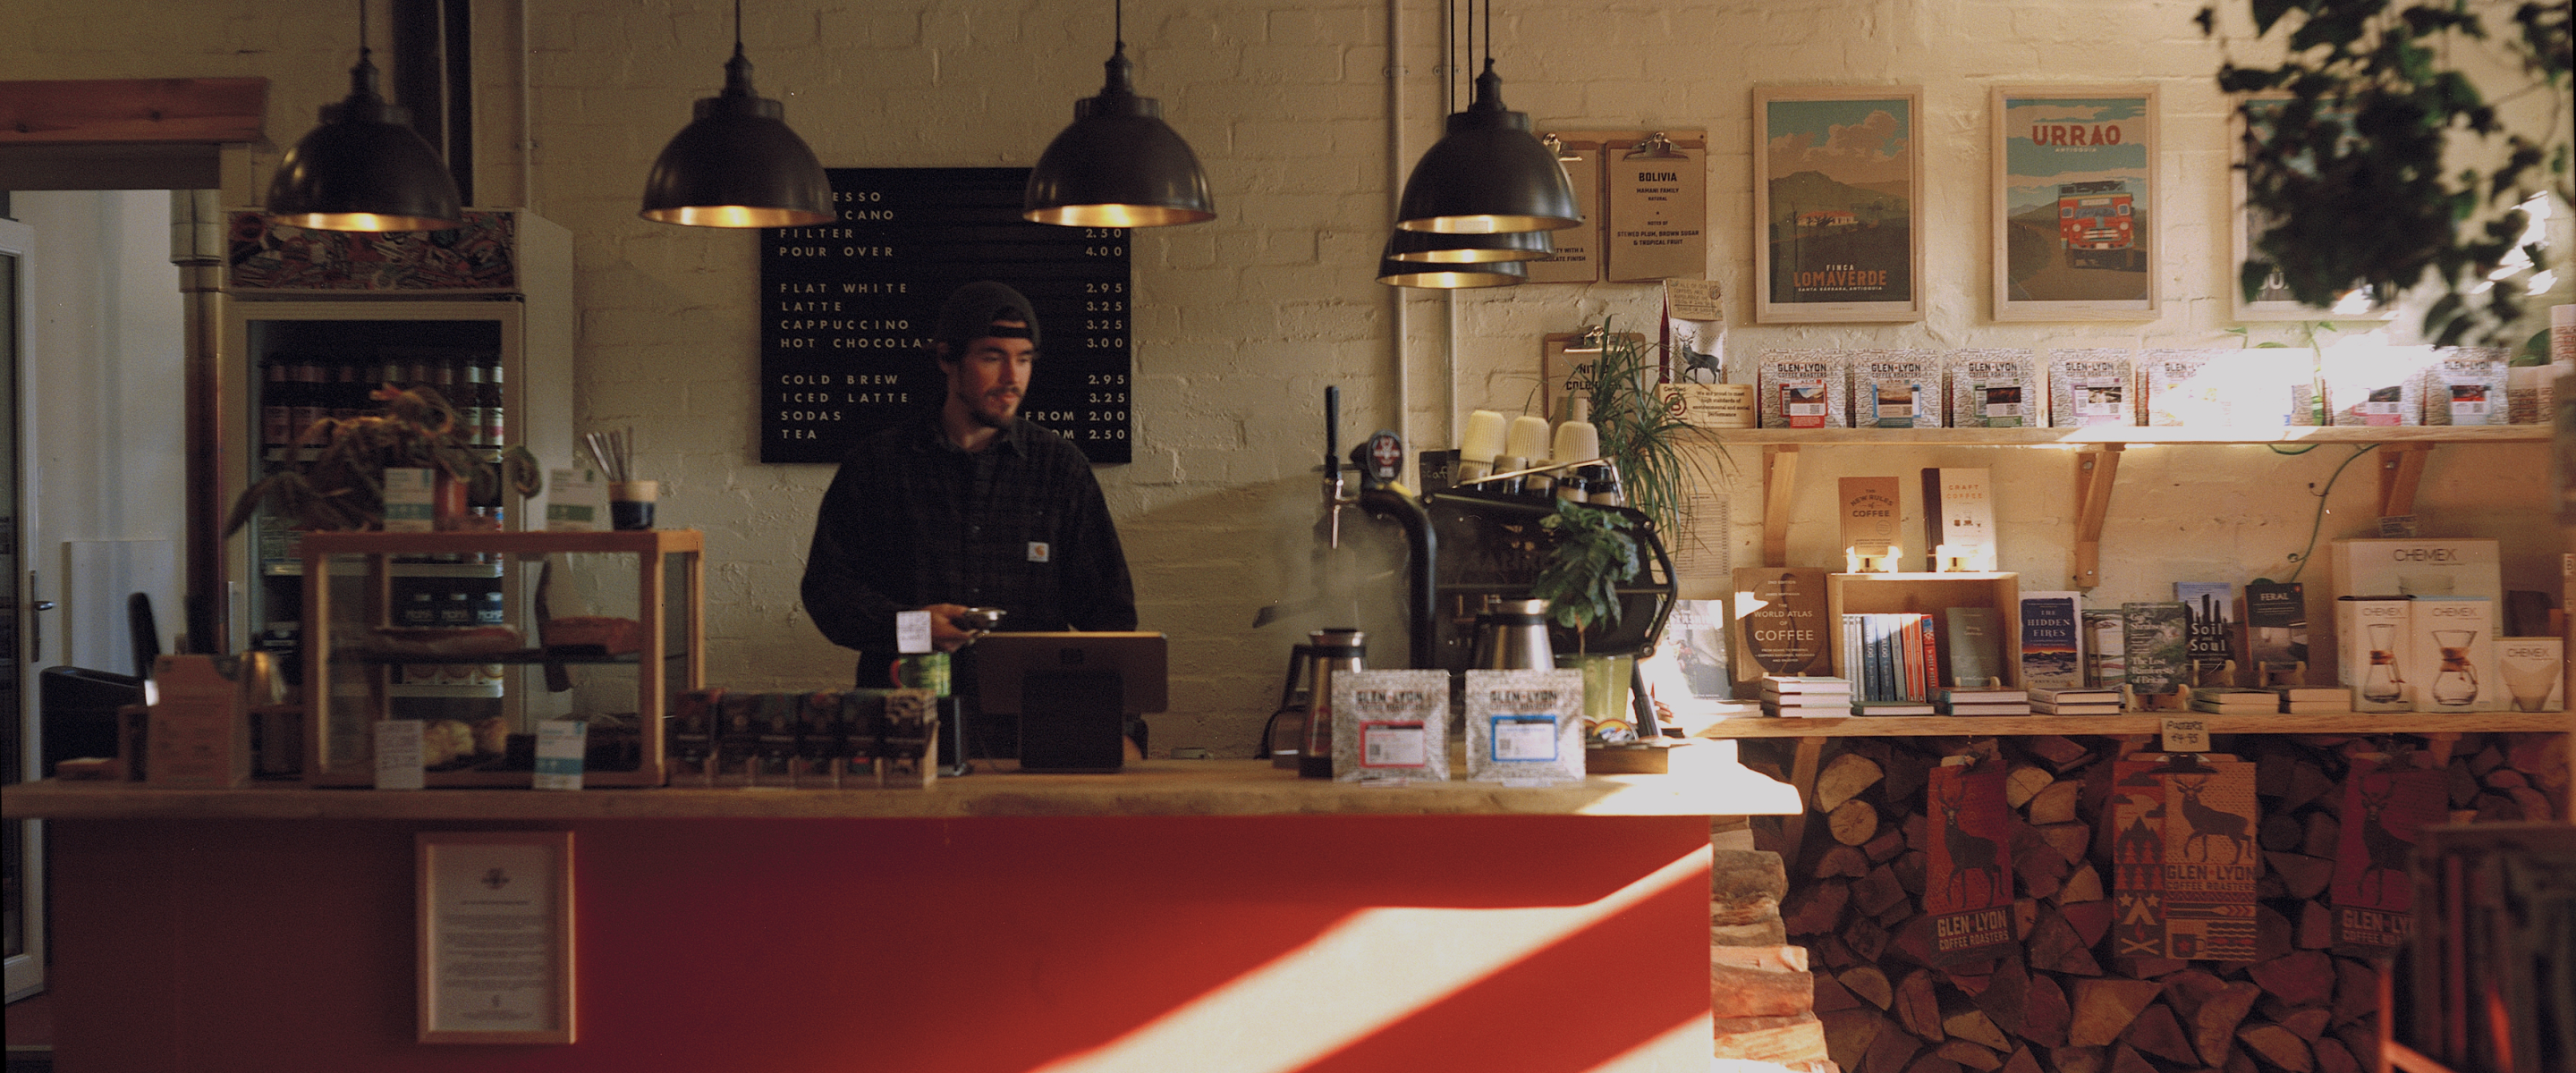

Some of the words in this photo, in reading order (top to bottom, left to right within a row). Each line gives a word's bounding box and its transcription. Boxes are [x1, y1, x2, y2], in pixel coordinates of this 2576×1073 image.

[2032, 125, 2121, 146] URRAO
[1639, 173, 1677, 182] BOLIVIA
[833, 192, 881, 202] ESSO
[780, 229, 853, 238] FILTER
[1086, 229, 1122, 238] 2.50
[780, 247, 826, 257] POUR
[844, 247, 893, 257] OVER
[1086, 247, 1122, 256] 4.00
[1793, 270, 1886, 287] LOMAVERDE
[781, 284, 826, 293] FLAT
[843, 284, 907, 293] WHITE
[1087, 283, 1122, 293] 2.95
[783, 302, 842, 311] LATTE
[1087, 302, 1122, 311] 3.25
[781, 320, 909, 329] CAPPUCCINO
[1087, 320, 1122, 330] 3.25
[781, 339, 815, 348] HOT
[834, 339, 934, 348] CHOCOLA
[1087, 338, 1123, 348] 3.00
[1778, 364, 1800, 372] GLEN
[1804, 364, 1826, 372] LYON
[1871, 364, 1894, 372] GLEN
[1898, 364, 1920, 372] LYON
[1969, 363, 1991, 371] GLEN
[1996, 363, 2017, 371] LYON
[2065, 362, 2088, 371] GLEN
[2092, 362, 2114, 370] LYON
[2165, 363, 2187, 371] GLEN
[782, 375, 830, 384] COLD
[847, 375, 898, 384] BREW
[1089, 375, 1124, 384] 2.95
[783, 393, 829, 402] ICED
[849, 393, 908, 402] LATTE
[1089, 393, 1124, 402] 3.25
[781, 411, 842, 420] SODAS
[1025, 411, 1074, 421] FROM
[1089, 411, 1124, 421] 2.00
[783, 429, 817, 439] TEA
[1089, 430, 1124, 439] 2.50
[1851, 495, 1867, 506] NEW
[1869, 494, 1893, 506] RULES
[2394, 549, 2458, 562] CHEMEX
[2260, 593, 2289, 601] FERAL
[2363, 607, 2402, 616] CHEMEX
[2433, 608, 2477, 617] CHEMEX
[2033, 629, 2066, 638] FIRES
[2191, 623, 2223, 635] Soil
[1755, 630, 1814, 641] COFFEE
[2190, 639, 2226, 652] Soul
[2508, 648, 2550, 657] CHEMEX
[2166, 866, 2207, 880] GLEN
[2216, 866, 2256, 880] LYON
[2166, 882, 2202, 890] COFFEE
[2207, 882, 2256, 891] ROASTERS
[1937, 916, 1970, 937] GLEN
[1975, 910, 2007, 932] LYON
[1939, 935, 1968, 950] COFFEE
[1970, 930, 2010, 946] ROASTERS
